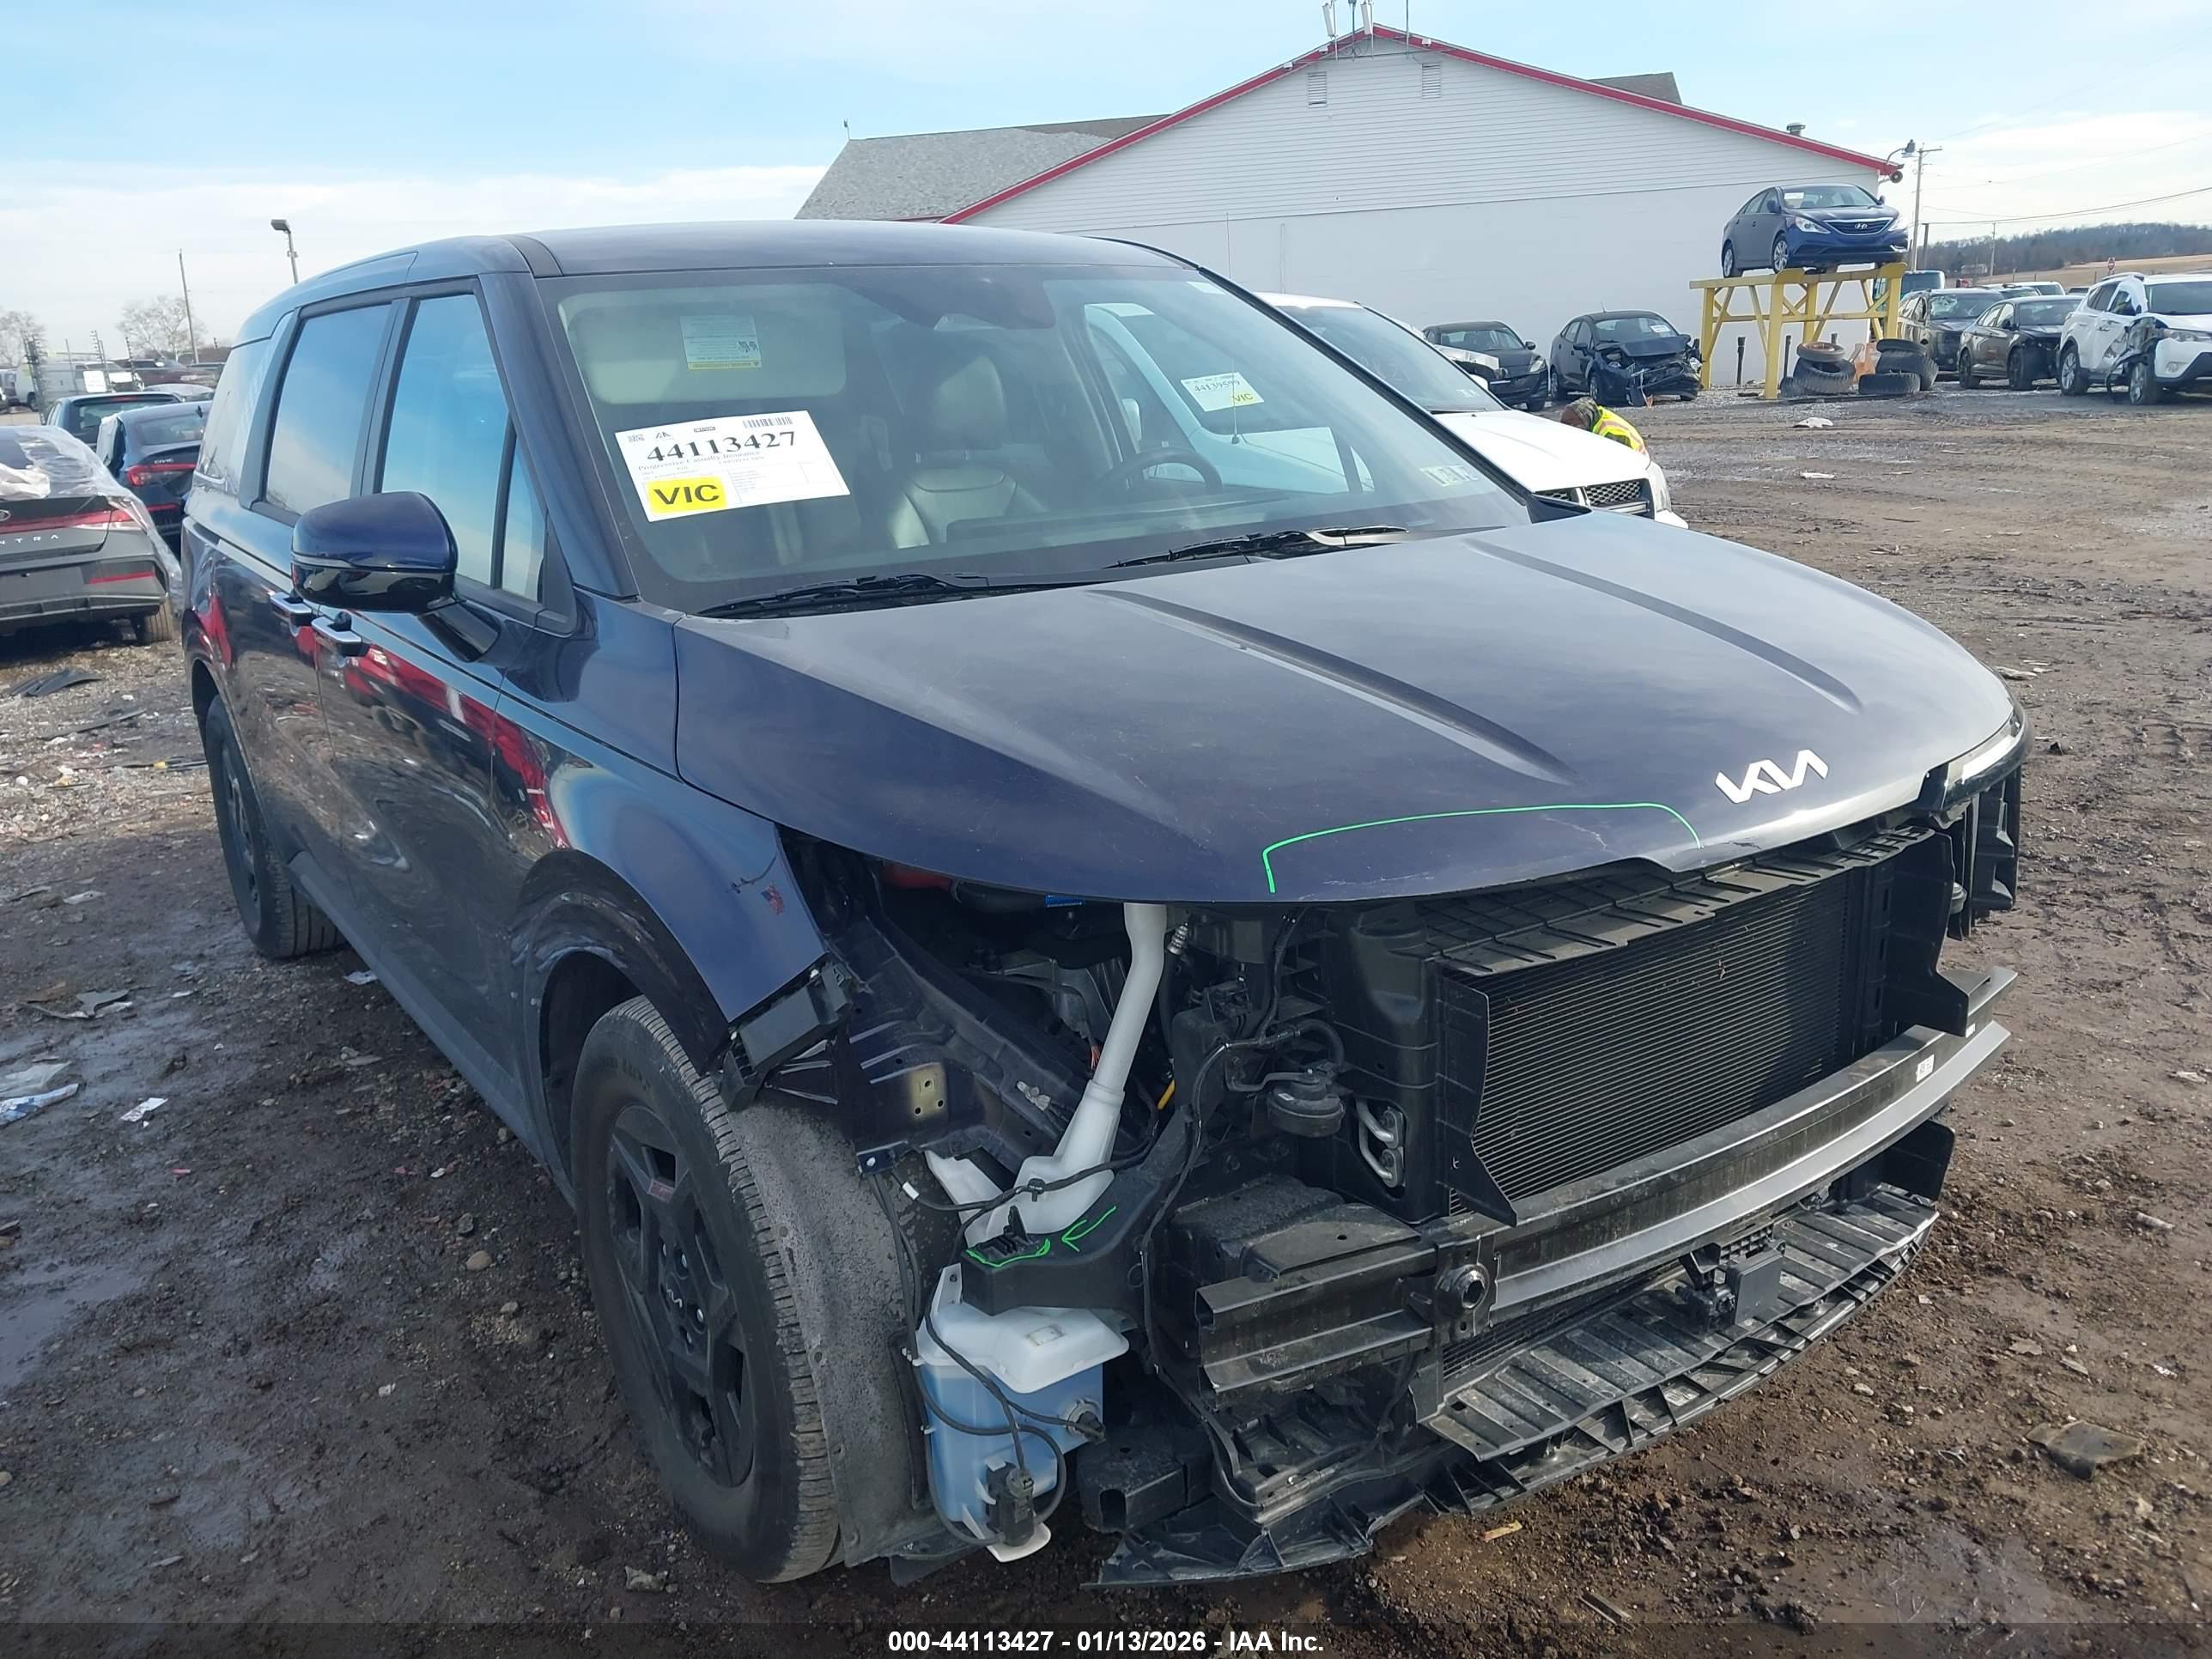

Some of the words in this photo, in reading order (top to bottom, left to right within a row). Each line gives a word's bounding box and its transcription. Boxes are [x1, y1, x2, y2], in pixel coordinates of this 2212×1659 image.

[1234, 393, 1254, 402] VIC
[647, 431, 795, 462] 44113427
[653, 483, 720, 506] VIC
[1715, 749, 1829, 804] KIA
